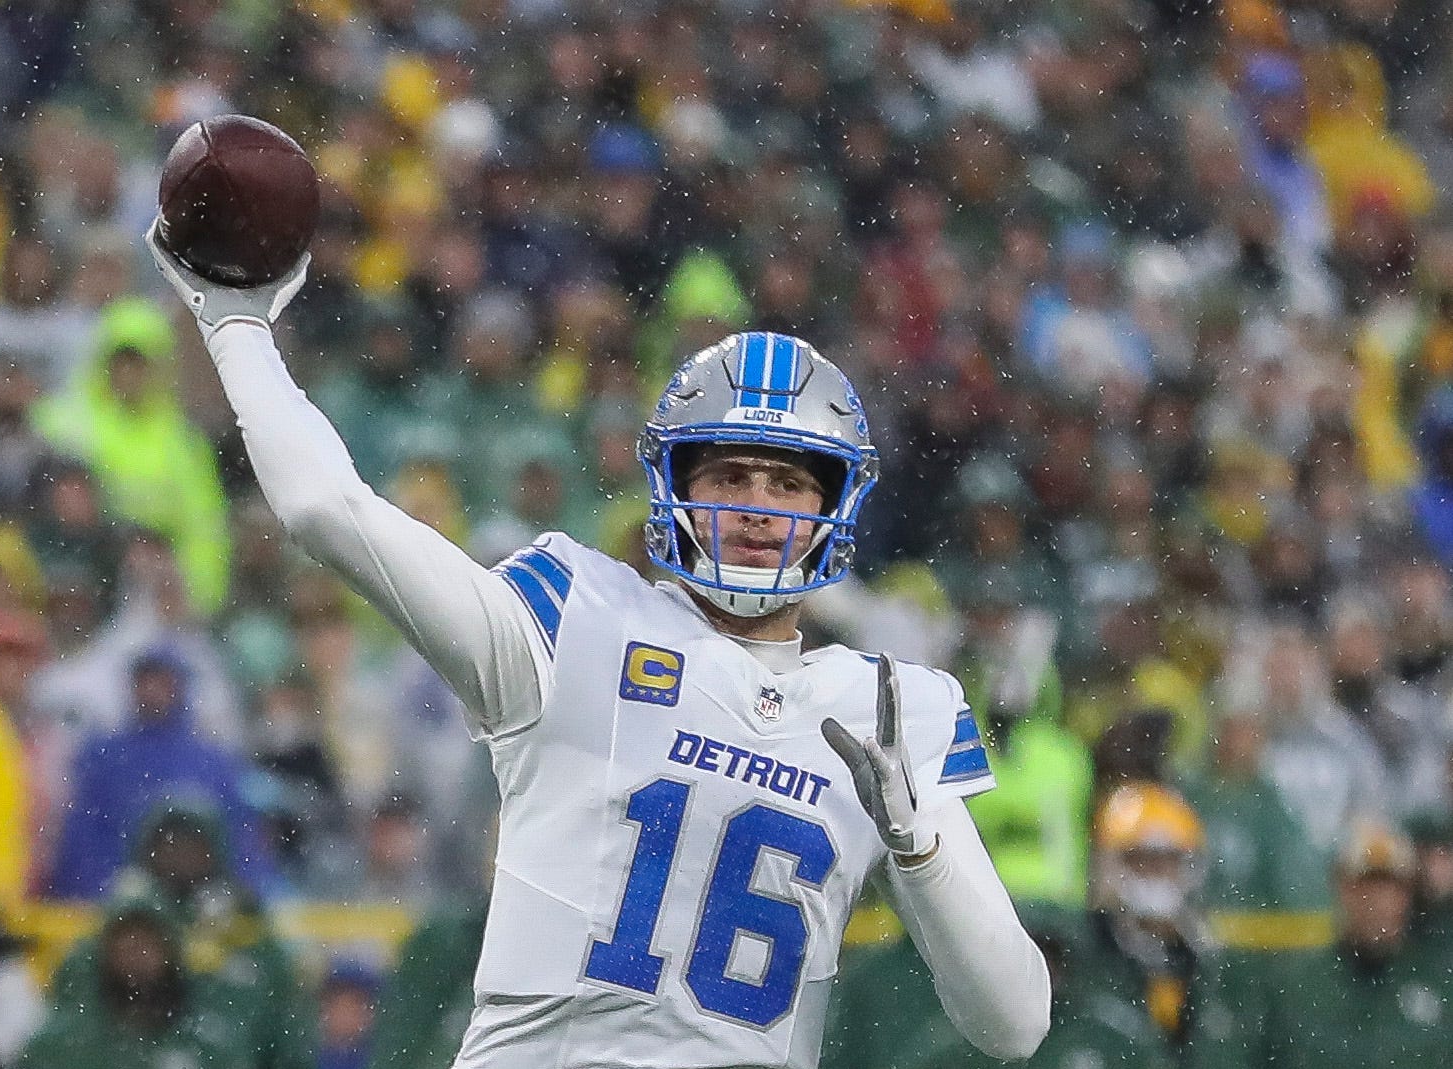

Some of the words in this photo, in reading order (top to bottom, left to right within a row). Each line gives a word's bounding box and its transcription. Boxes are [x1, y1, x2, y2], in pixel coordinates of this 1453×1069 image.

[628, 647, 679, 690] C
[667, 729, 832, 806] DETROIT
[580, 774, 839, 1031] 16
